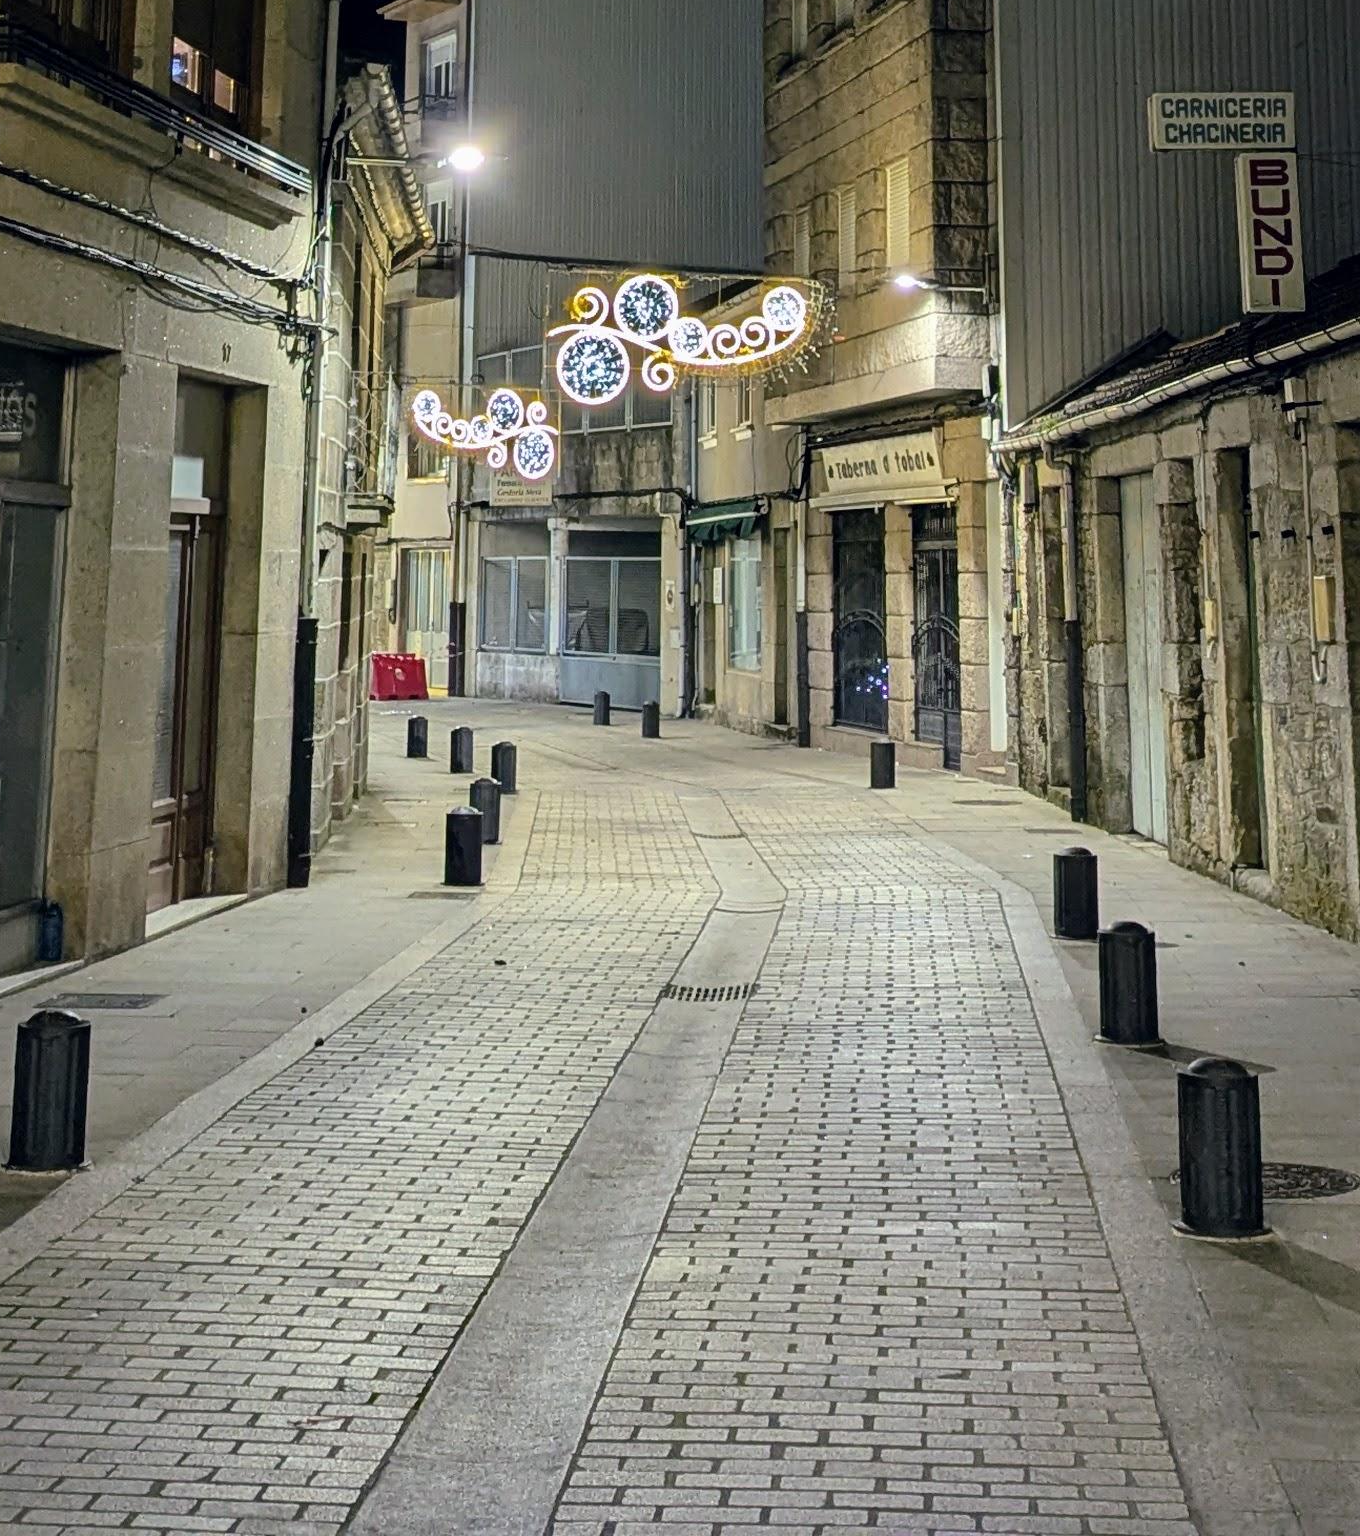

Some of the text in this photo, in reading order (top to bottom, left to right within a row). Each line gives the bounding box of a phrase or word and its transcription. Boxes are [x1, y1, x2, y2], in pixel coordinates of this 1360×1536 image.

[1160, 97, 1287, 119] CARNICERIA
[1164, 122, 1286, 144] CHACINERIA
[1248, 158, 1295, 307] BUNDI
